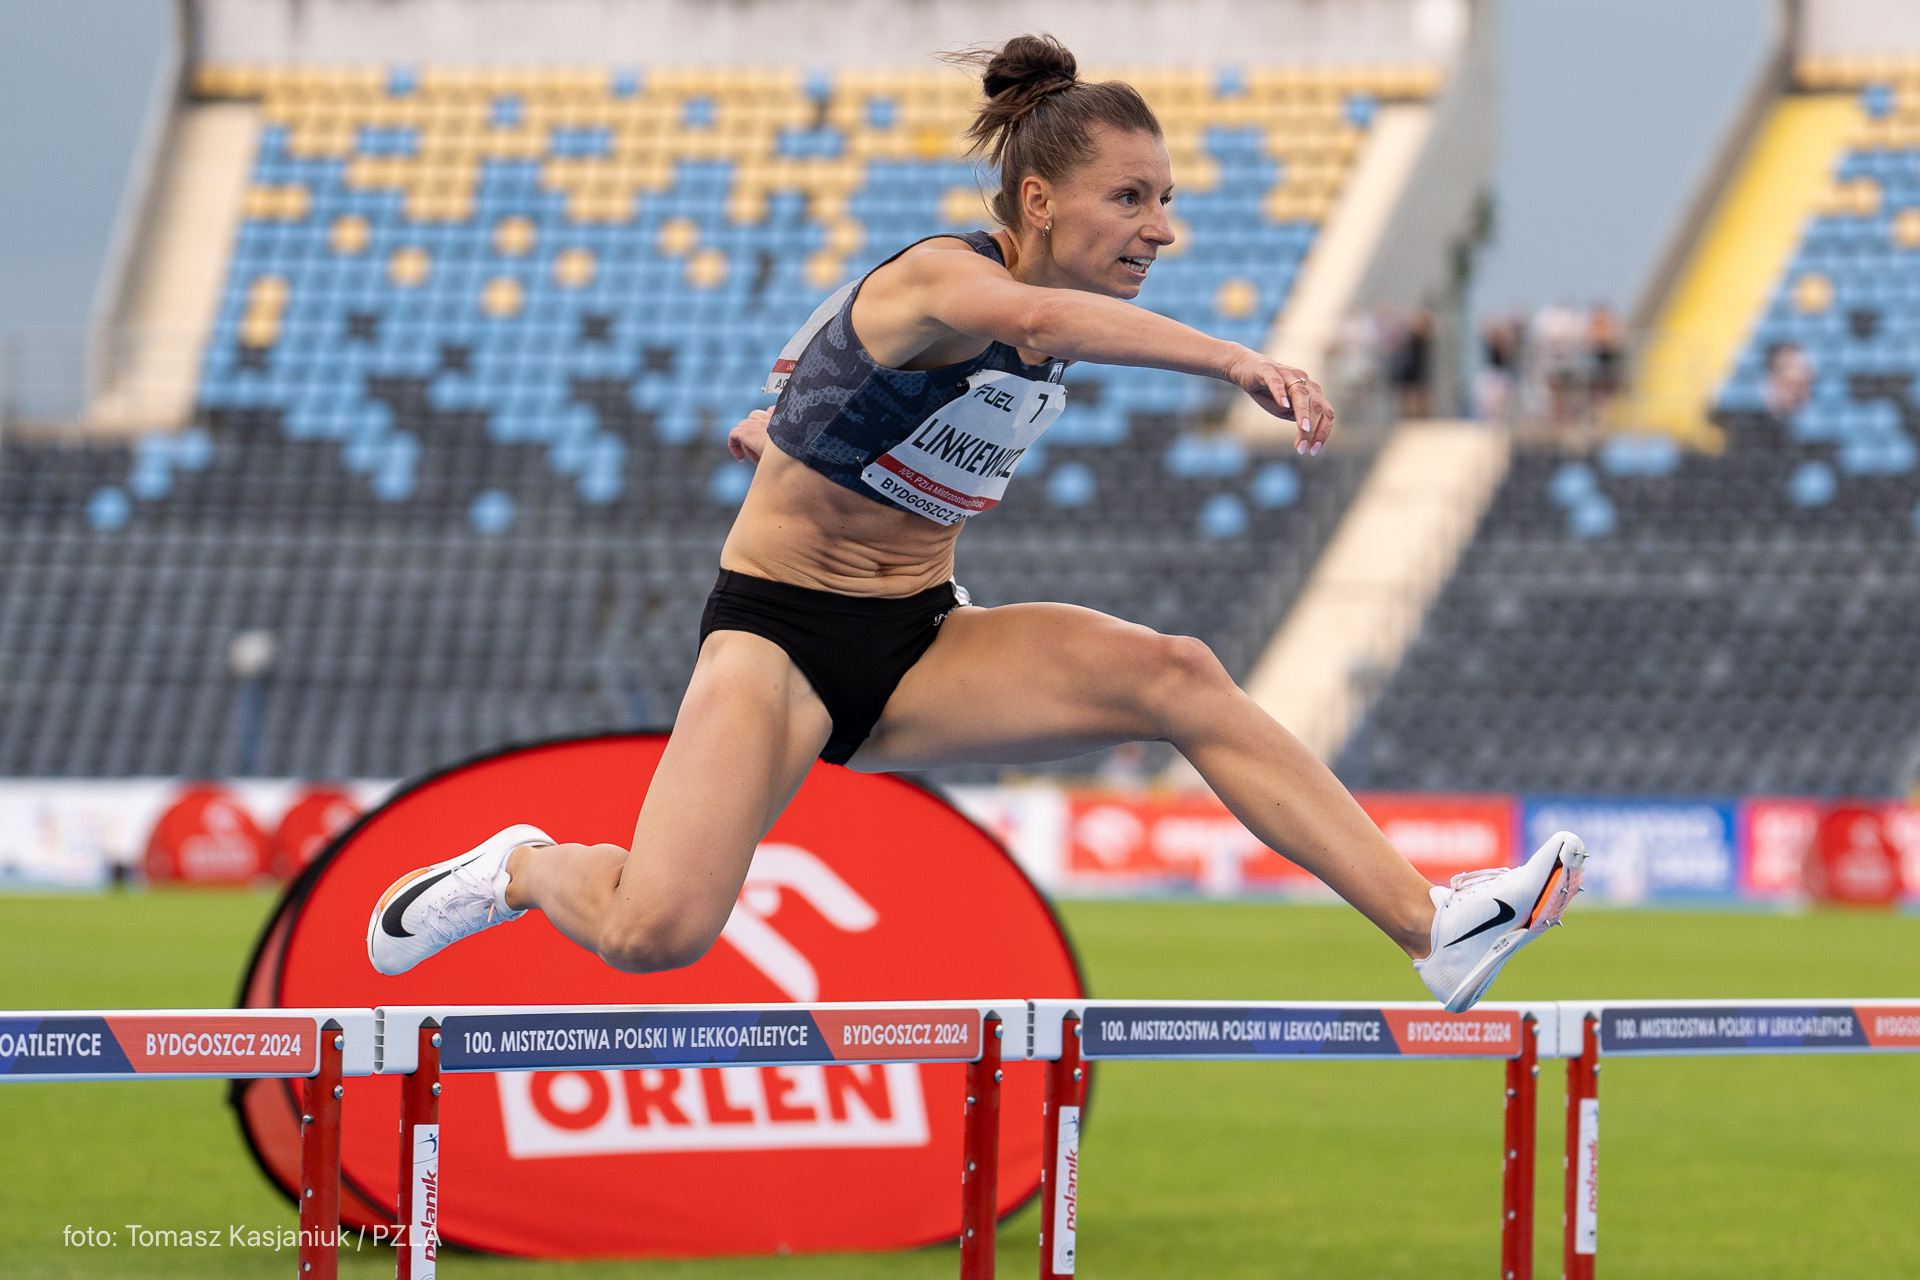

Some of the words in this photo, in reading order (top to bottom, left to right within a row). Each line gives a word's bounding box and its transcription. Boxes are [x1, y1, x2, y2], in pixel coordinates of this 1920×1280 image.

[973, 383, 1016, 412] FUEL
[1028, 393, 1049, 423] 7
[898, 467, 913, 480] 100.
[914, 476, 933, 491] PZLA
[880, 477, 955, 521] BYDGOSZCZ
[464, 1031, 496, 1053] 100.
[500, 1029, 610, 1052] MISTRZOSTWA
[615, 1027, 667, 1049] POLSKI
[671, 1027, 687, 1048] W
[691, 1025, 808, 1047] LEKKOATLETYCE
[843, 1024, 931, 1045] BYDGOSZCZ
[934, 1023, 968, 1044] 2024
[1100, 1021, 1127, 1041] 100.
[1130, 1020, 1219, 1041] MISTRZOSTWA
[1222, 1020, 1266, 1041] POLSKI
[1268, 1021, 1282, 1041] W
[1284, 1021, 1380, 1041] LEKKOATLETYCE
[1407, 1021, 1481, 1042] BYDGOSZCZ
[1482, 1022, 1511, 1042] 2024
[1615, 1019, 1640, 1038] 100.
[1640, 1018, 1716, 1038] MISTRZOSTWA
[1718, 1017, 1756, 1037] POLSKI
[1757, 1017, 1769, 1036] W
[1770, 1016, 1853, 1036] LEKKOATLETYCE
[0, 1033, 101, 1057] OATLETYCE
[146, 1033, 256, 1056] BYDGOSZCZ
[259, 1033, 301, 1056] 2024
[529, 1064, 895, 1131] ORLEN
[1063, 1148, 1078, 1232] polanik
[420, 1169, 437, 1263] polanik
